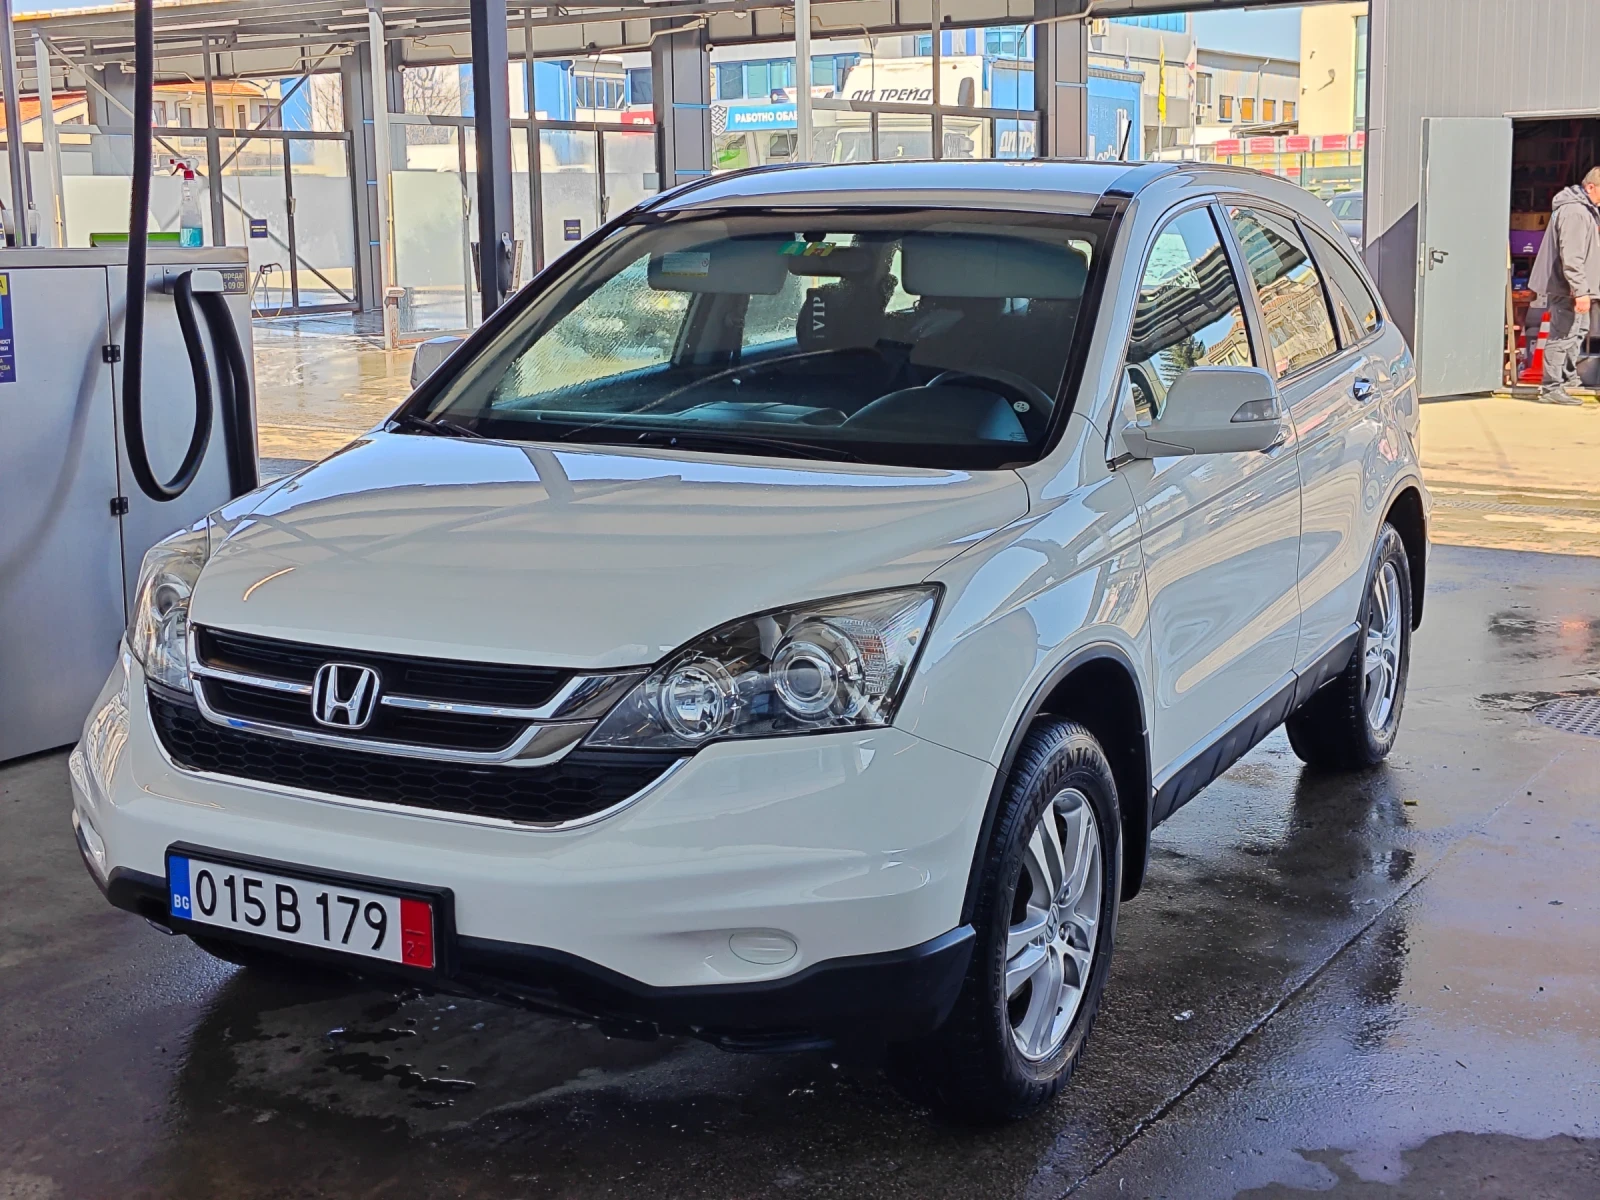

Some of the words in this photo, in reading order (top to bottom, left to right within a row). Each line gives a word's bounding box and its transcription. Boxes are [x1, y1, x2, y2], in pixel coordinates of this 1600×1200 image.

[880, 87, 932, 101] ТРЕЙД
[735, 112, 775, 123] РАБОТНО
[776, 111, 797, 121] ОБЛЕ
[813, 296, 825, 331] VIP
[173, 894, 190, 910] BG
